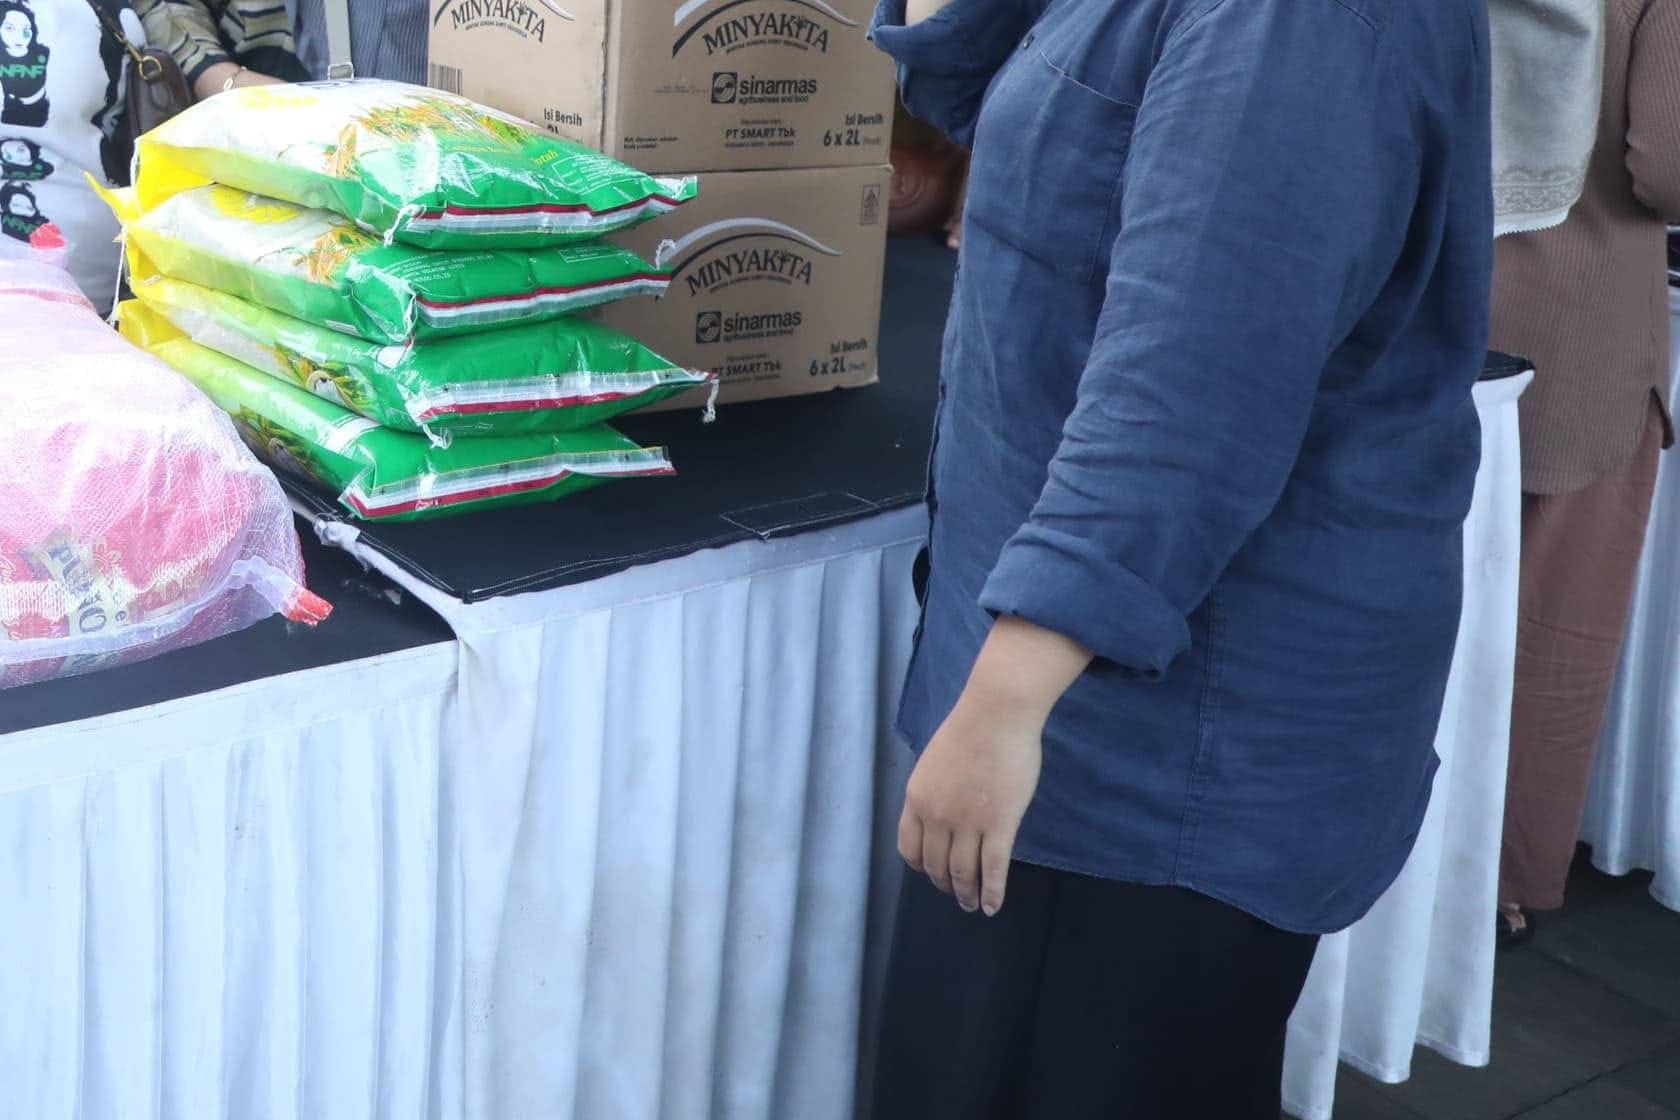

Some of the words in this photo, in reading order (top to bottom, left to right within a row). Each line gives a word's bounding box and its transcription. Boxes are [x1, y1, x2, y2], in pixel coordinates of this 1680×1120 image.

[702, 12, 829, 55] MINYAKITA
[739, 75, 817, 95] sinarmas
[555, 110, 582, 126] Bersih
[725, 128, 738, 139] PT
[740, 127, 776, 139] SMART
[823, 129, 832, 146] 6
[846, 128, 861, 145] 2L
[685, 249, 813, 297] MINYAKITA
[724, 311, 802, 333] sinarmas
